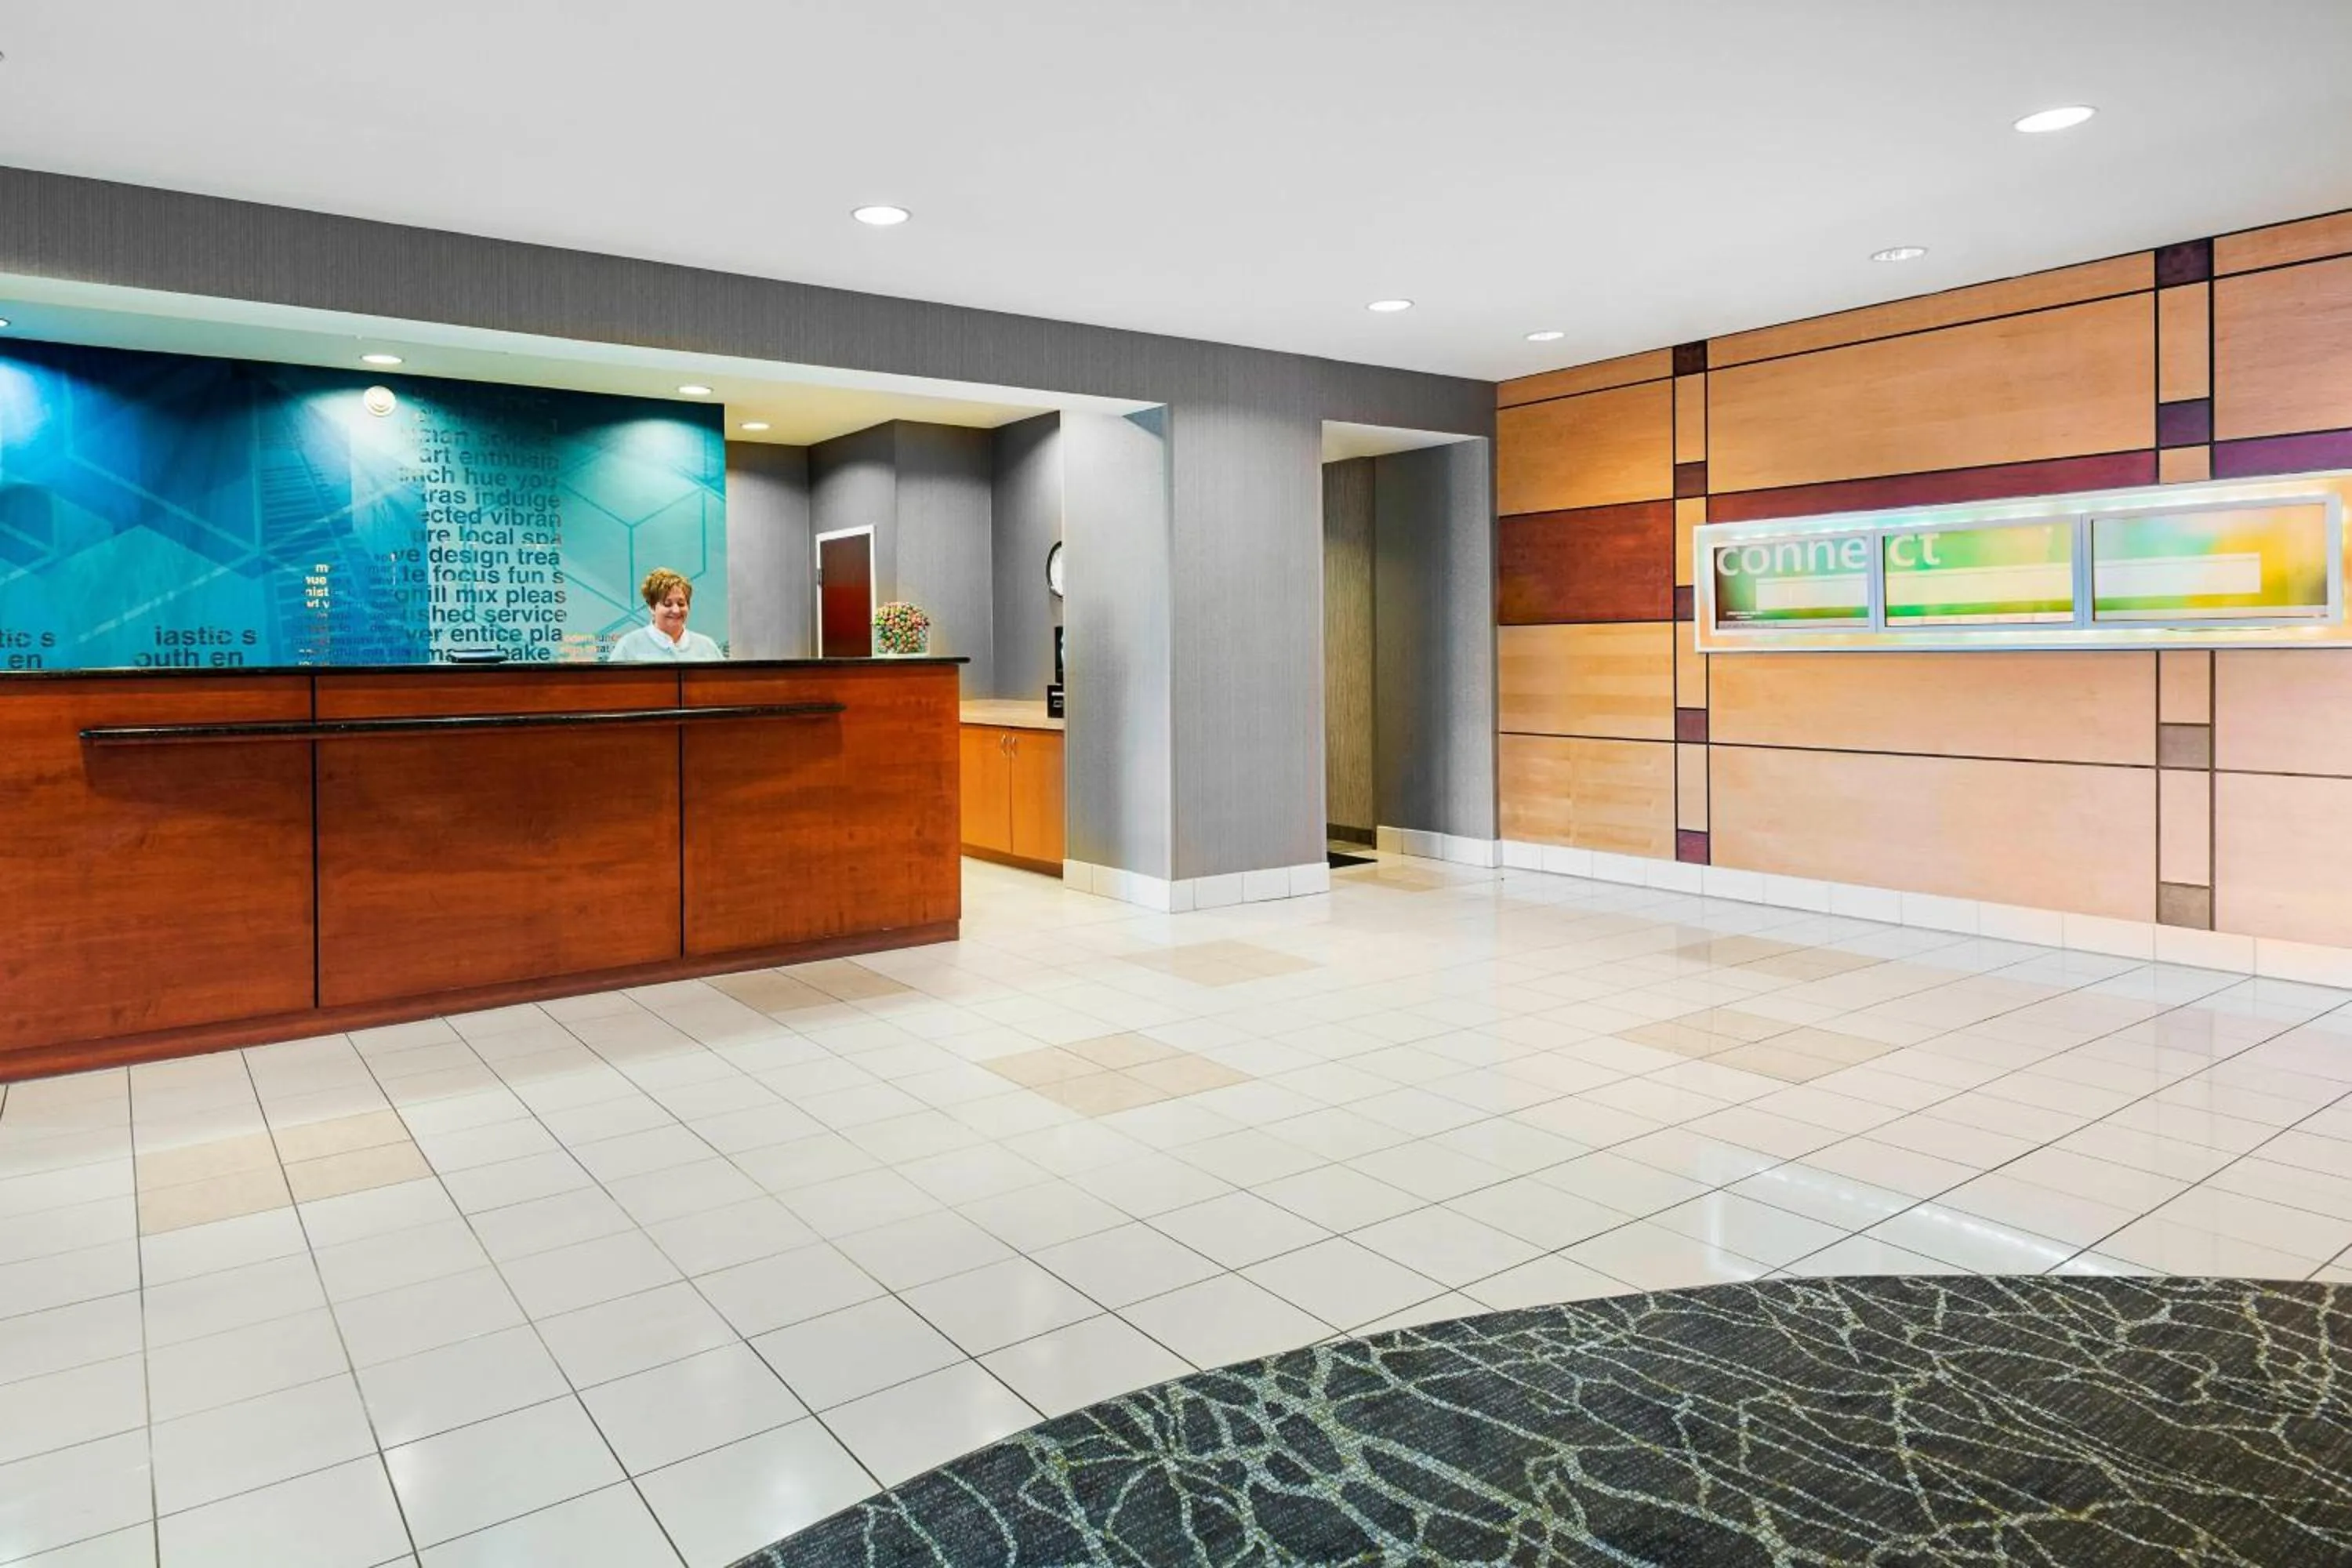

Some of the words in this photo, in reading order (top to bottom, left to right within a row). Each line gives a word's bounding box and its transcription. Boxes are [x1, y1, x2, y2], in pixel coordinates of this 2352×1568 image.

[465, 467, 507, 486] hue
[459, 525, 514, 545] local
[429, 546, 509, 568] design
[517, 547, 561, 565] trea
[434, 564, 500, 583] focus
[509, 564, 545, 583] fun
[552, 568, 564, 584] s
[456, 589, 498, 604] mix
[506, 585, 567, 606] pleas
[484, 605, 567, 625] service
[449, 626, 524, 643] entice
[529, 624, 563, 644] pla
